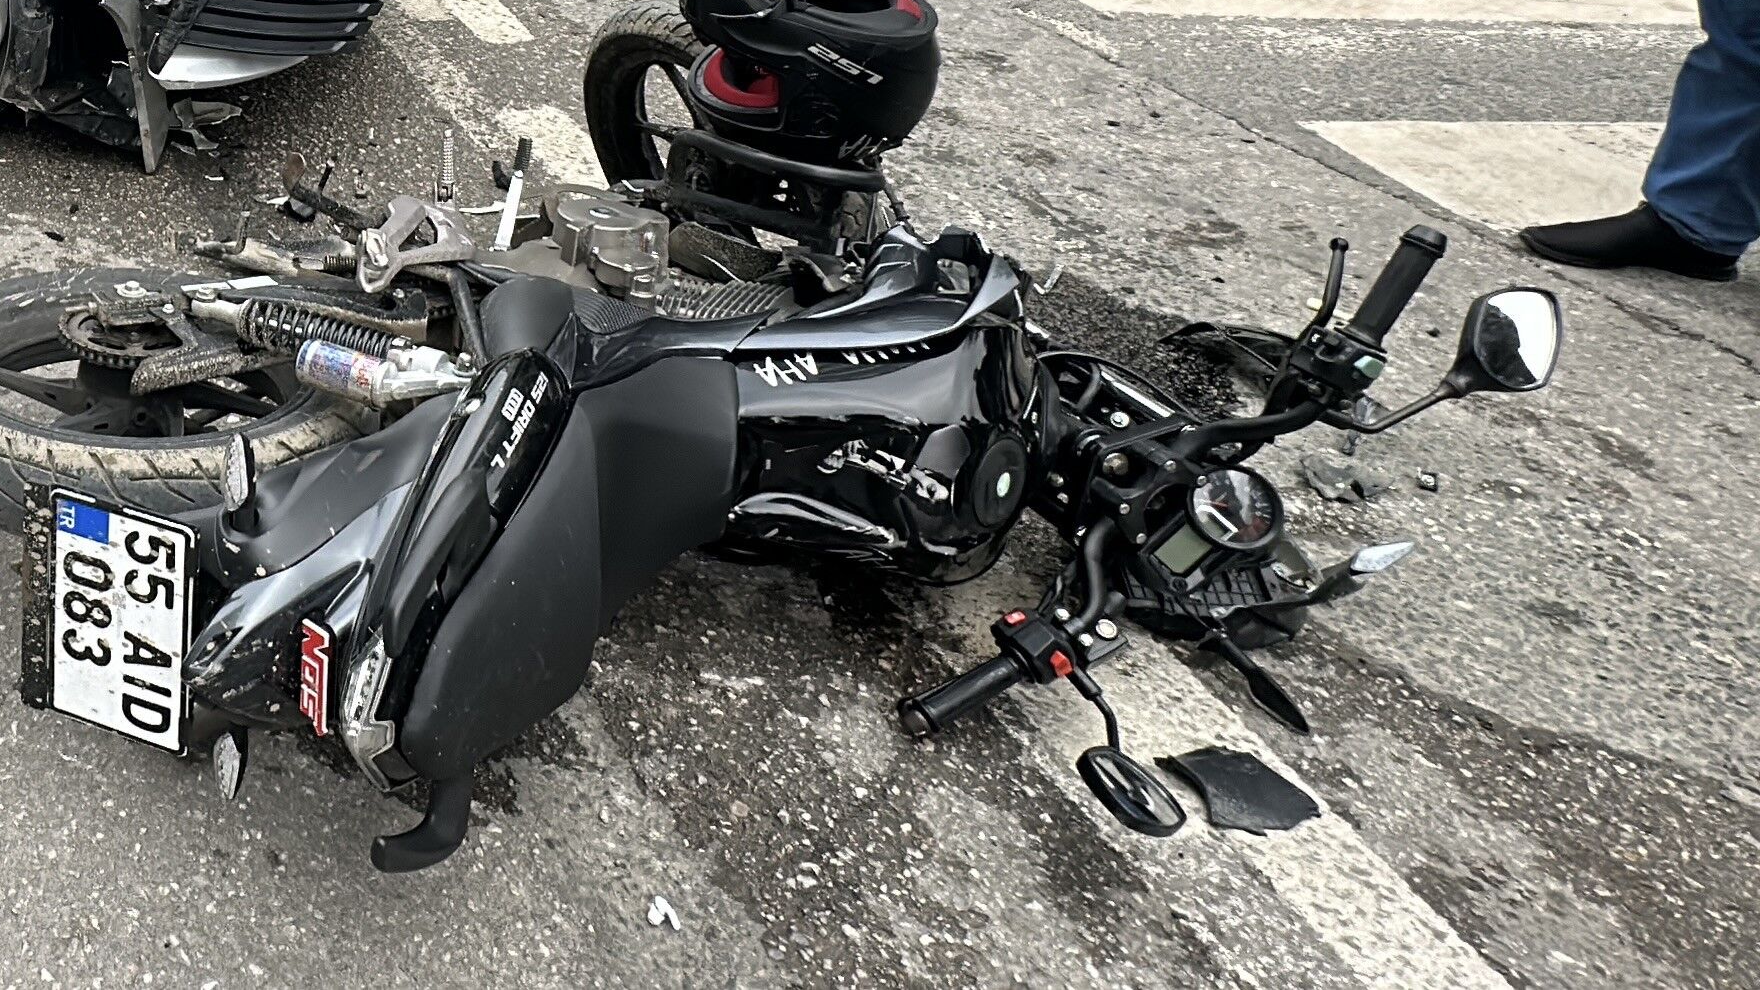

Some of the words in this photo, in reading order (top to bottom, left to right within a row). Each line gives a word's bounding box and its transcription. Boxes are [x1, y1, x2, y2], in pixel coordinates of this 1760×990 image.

[530, 371, 549, 405] 125
[502, 399, 536, 459] DRIFT
[490, 453, 506, 468] L
[59, 506, 75, 529] TR
[124, 531, 176, 610] 55
[62, 550, 114, 667] 083
[122, 630, 173, 734] AID
